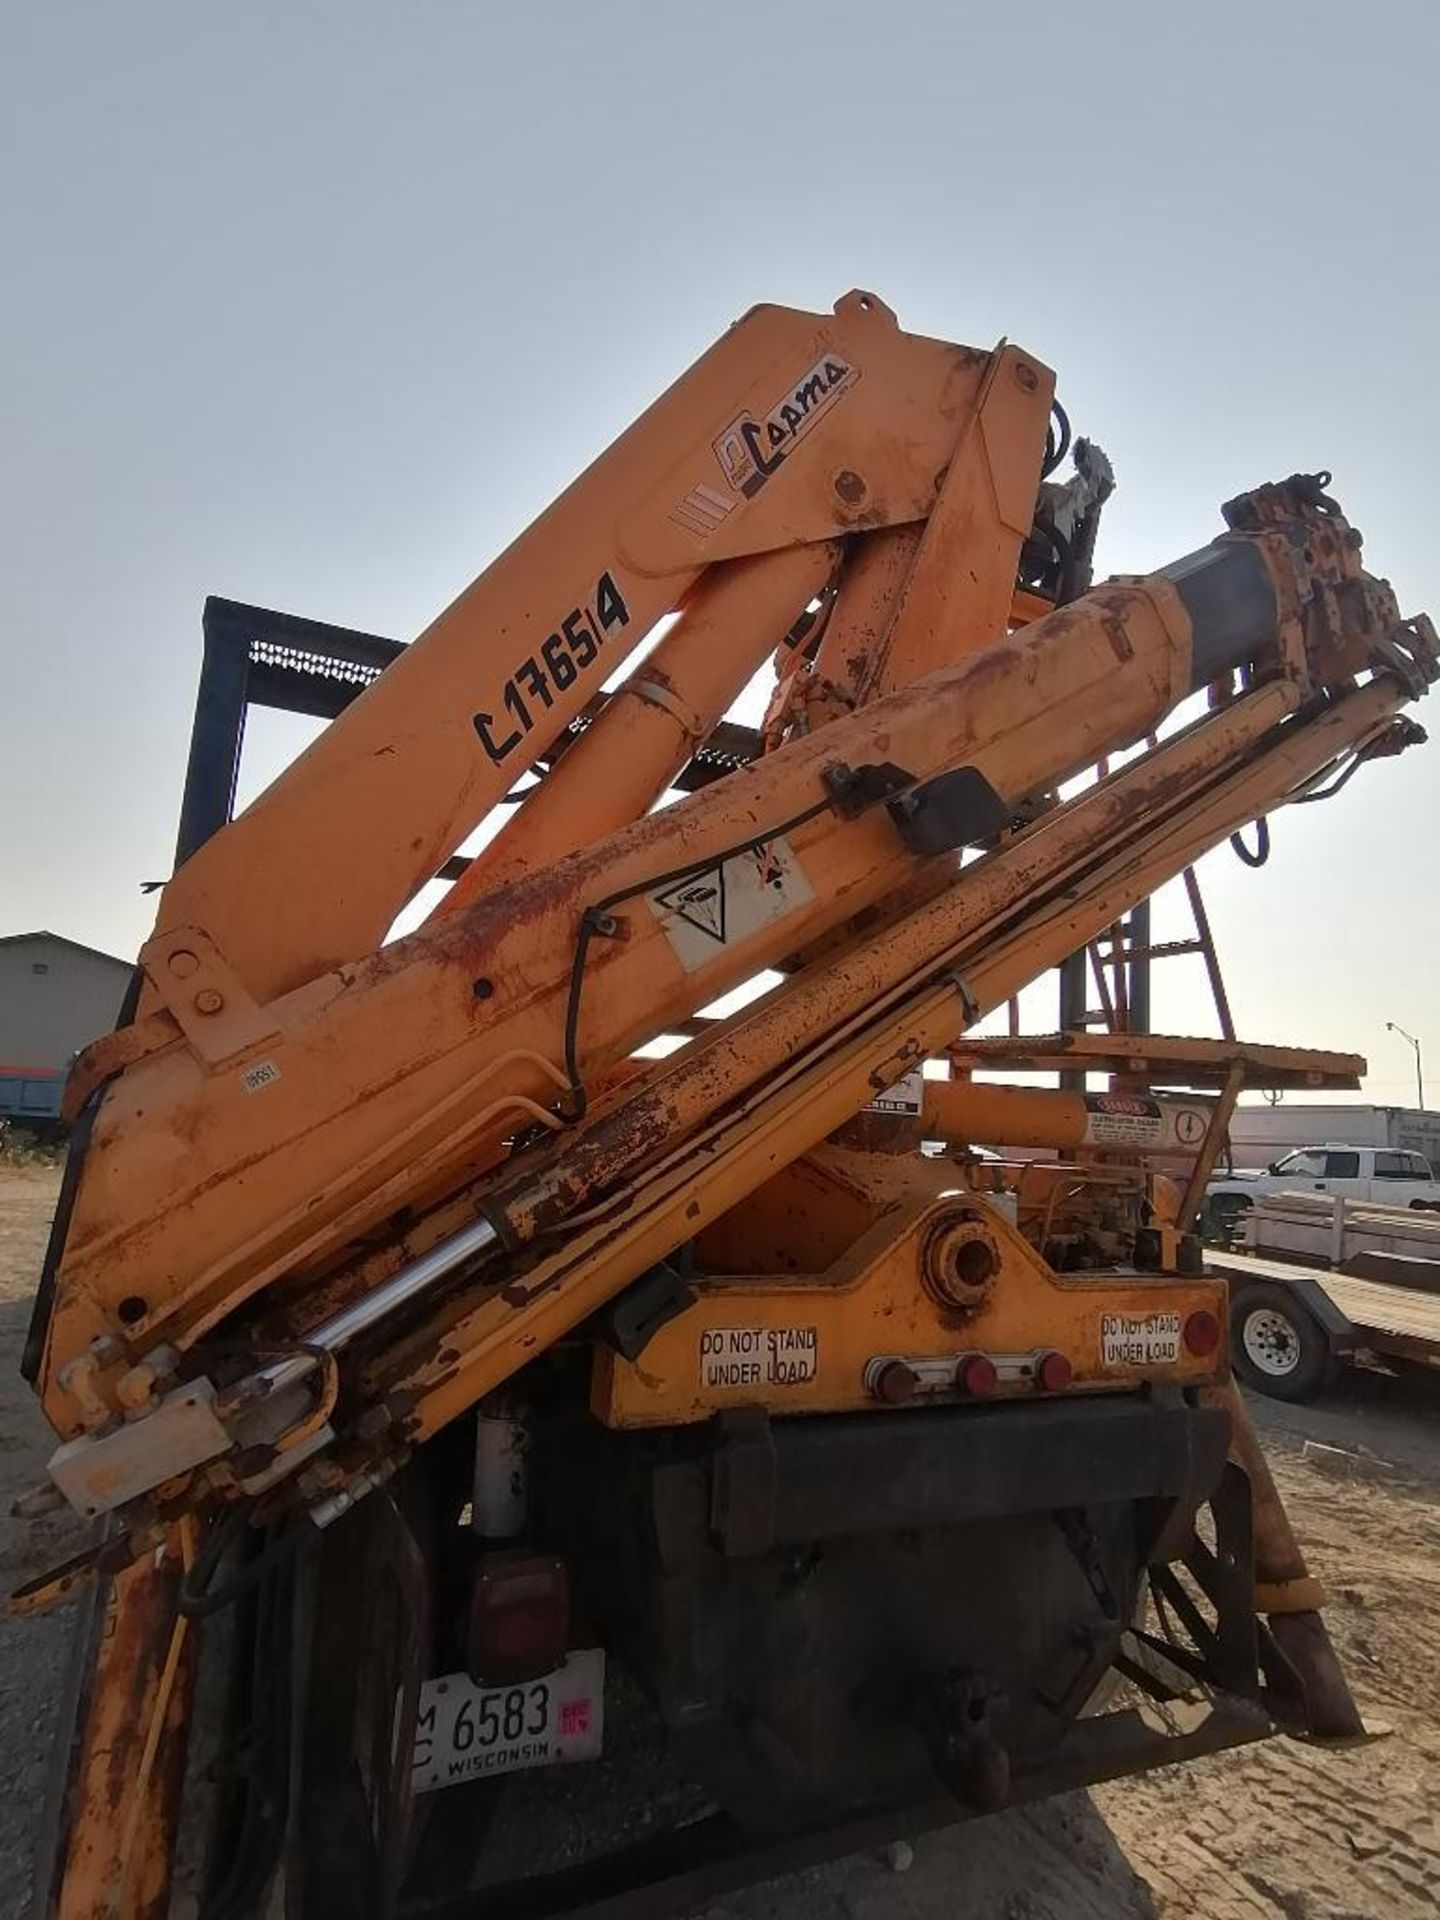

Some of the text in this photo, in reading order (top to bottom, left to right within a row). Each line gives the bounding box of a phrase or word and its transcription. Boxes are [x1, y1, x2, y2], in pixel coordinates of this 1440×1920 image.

[701, 1329, 818, 1355] DO NOT STAND
[1108, 1342, 1175, 1362] UNDER LOAD
[707, 1360, 808, 1387] UNDER LOAD
[452, 1683, 551, 1752] 6583
[447, 1741, 550, 1777] WISCONSIN
